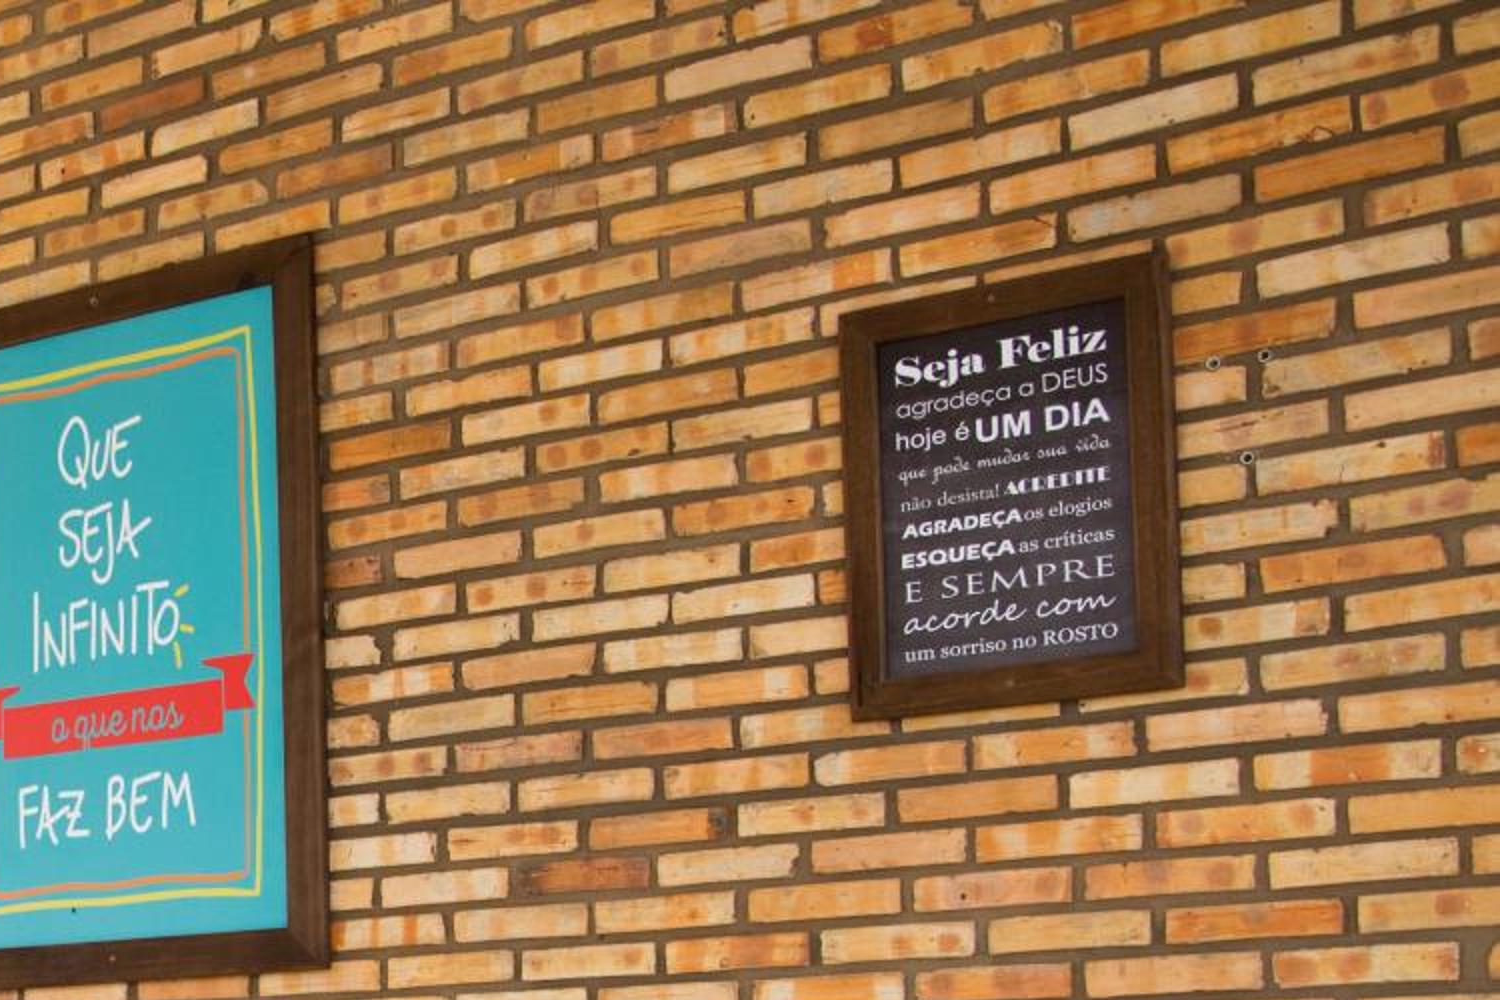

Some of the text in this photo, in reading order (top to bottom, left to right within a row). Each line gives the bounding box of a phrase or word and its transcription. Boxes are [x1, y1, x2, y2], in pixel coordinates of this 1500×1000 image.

[895, 325, 1108, 388] Seja Feliz
[896, 362, 1109, 420] agradeça a DEUS
[56, 413, 143, 489] QUE
[895, 397, 1111, 451] hoje é UM DIA
[899, 433, 1111, 487] que pode mudar sua vida
[901, 466, 1111, 513] não desista! ACREDITE
[57, 498, 152, 586] SEJA
[902, 496, 1113, 540] AGRADEÇA os elogios
[901, 528, 1116, 570] ESQUEÇA as críticas
[905, 553, 1116, 603] E SEMPRE
[30, 578, 182, 673] INFINITO
[903, 593, 1117, 635] acorde com
[905, 621, 1119, 663] um sorriso no ROSTO
[51, 699, 185, 752] o que nos
[18, 770, 198, 850] FAZ BEM
